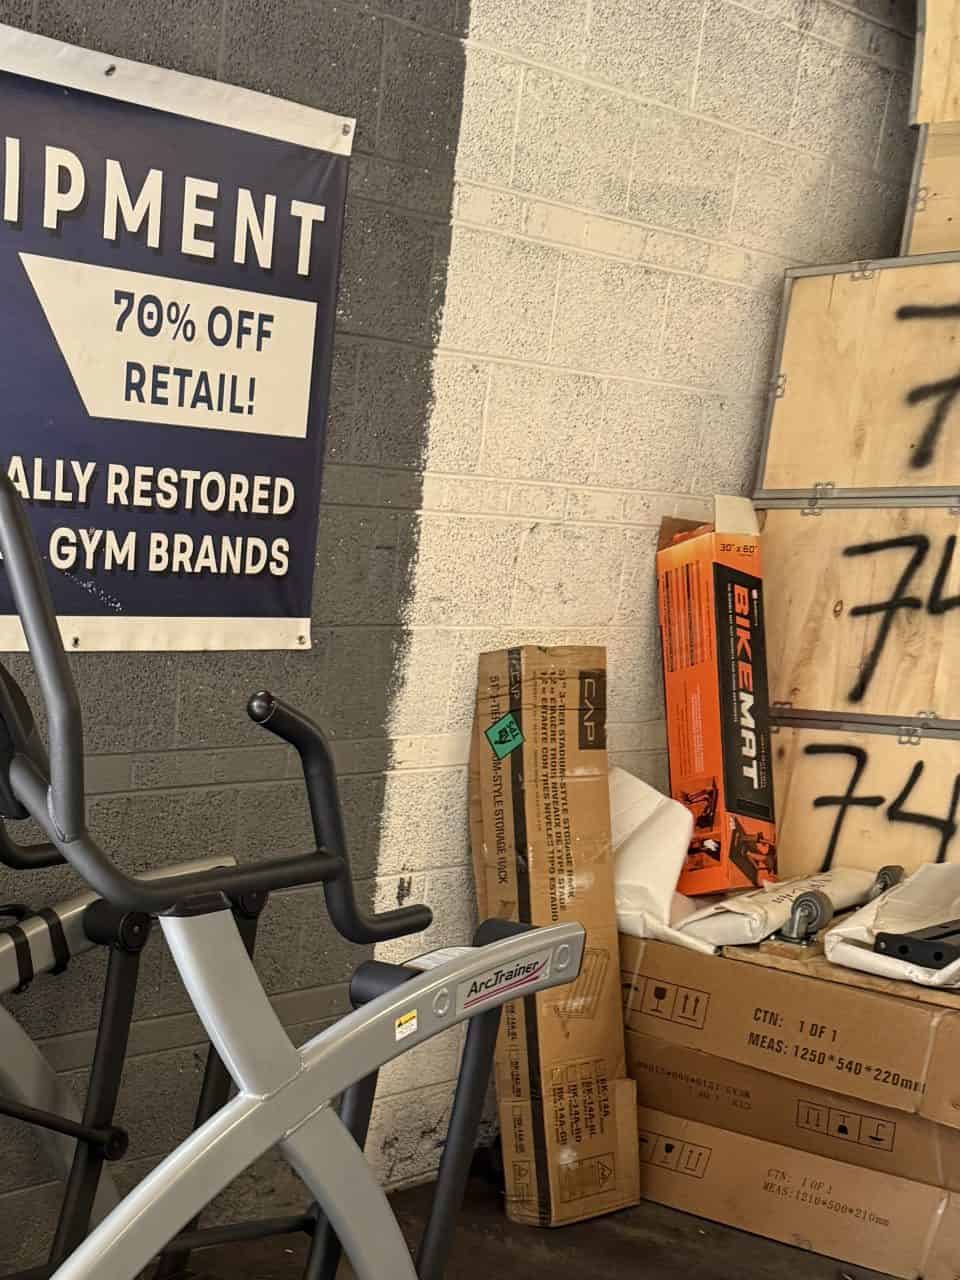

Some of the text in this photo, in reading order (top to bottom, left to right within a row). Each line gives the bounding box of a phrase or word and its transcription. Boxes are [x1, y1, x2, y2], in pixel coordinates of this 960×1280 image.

[113, 289, 275, 352] 70% OFF
[124, 361, 256, 416] RETAIL!
[107, 470, 295, 516] RESTORED
[49, 525, 136, 571] GYM
[148, 532, 289, 576] BRANDS
[583, 677, 596, 743] CAP
[466, 960, 540, 998] ArcTrainer
[748, 1032, 789, 1055] MEAS:
[753, 1008, 838, 1042] CTN: 1 OF 1
